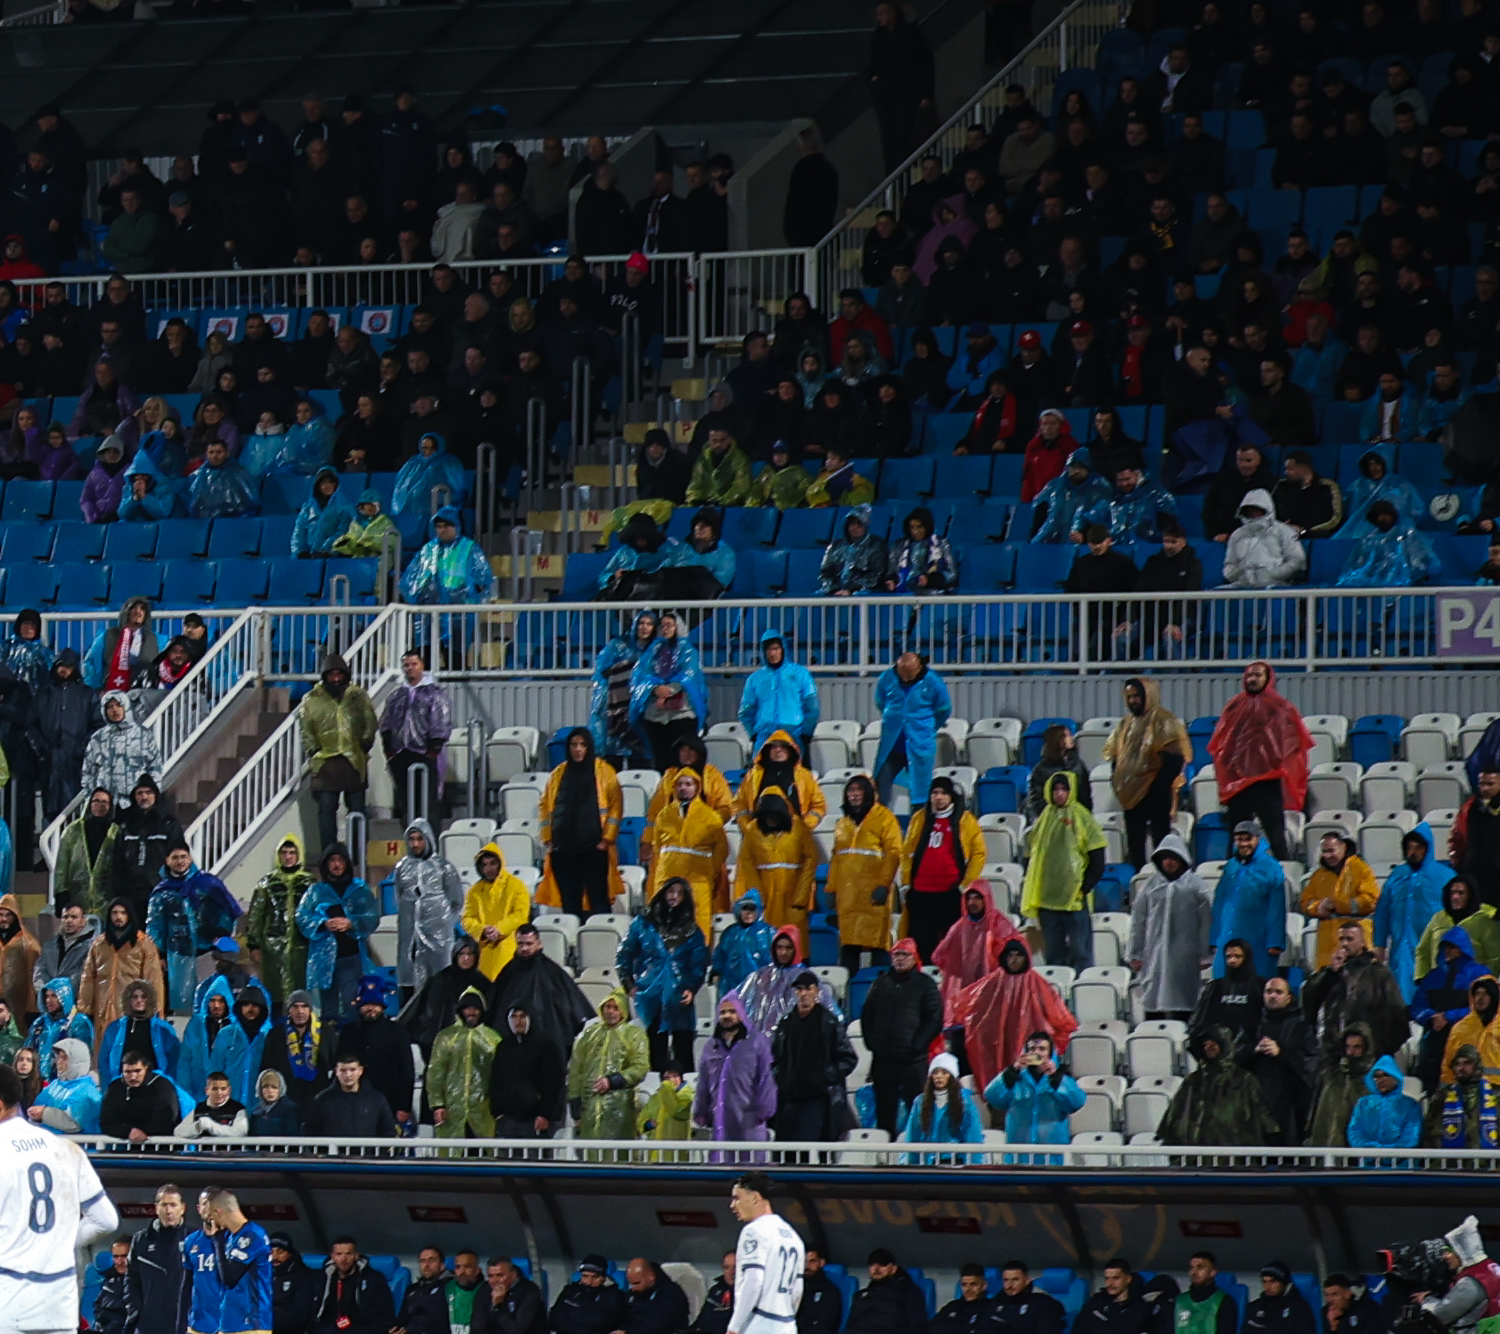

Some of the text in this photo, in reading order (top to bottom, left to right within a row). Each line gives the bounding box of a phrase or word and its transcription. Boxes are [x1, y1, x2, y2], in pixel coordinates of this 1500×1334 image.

[1441, 597, 1500, 649] P4
[11, 1137, 49, 1153] SOHM
[27, 1162, 56, 1234] 8
[197, 1253, 214, 1272] 14
